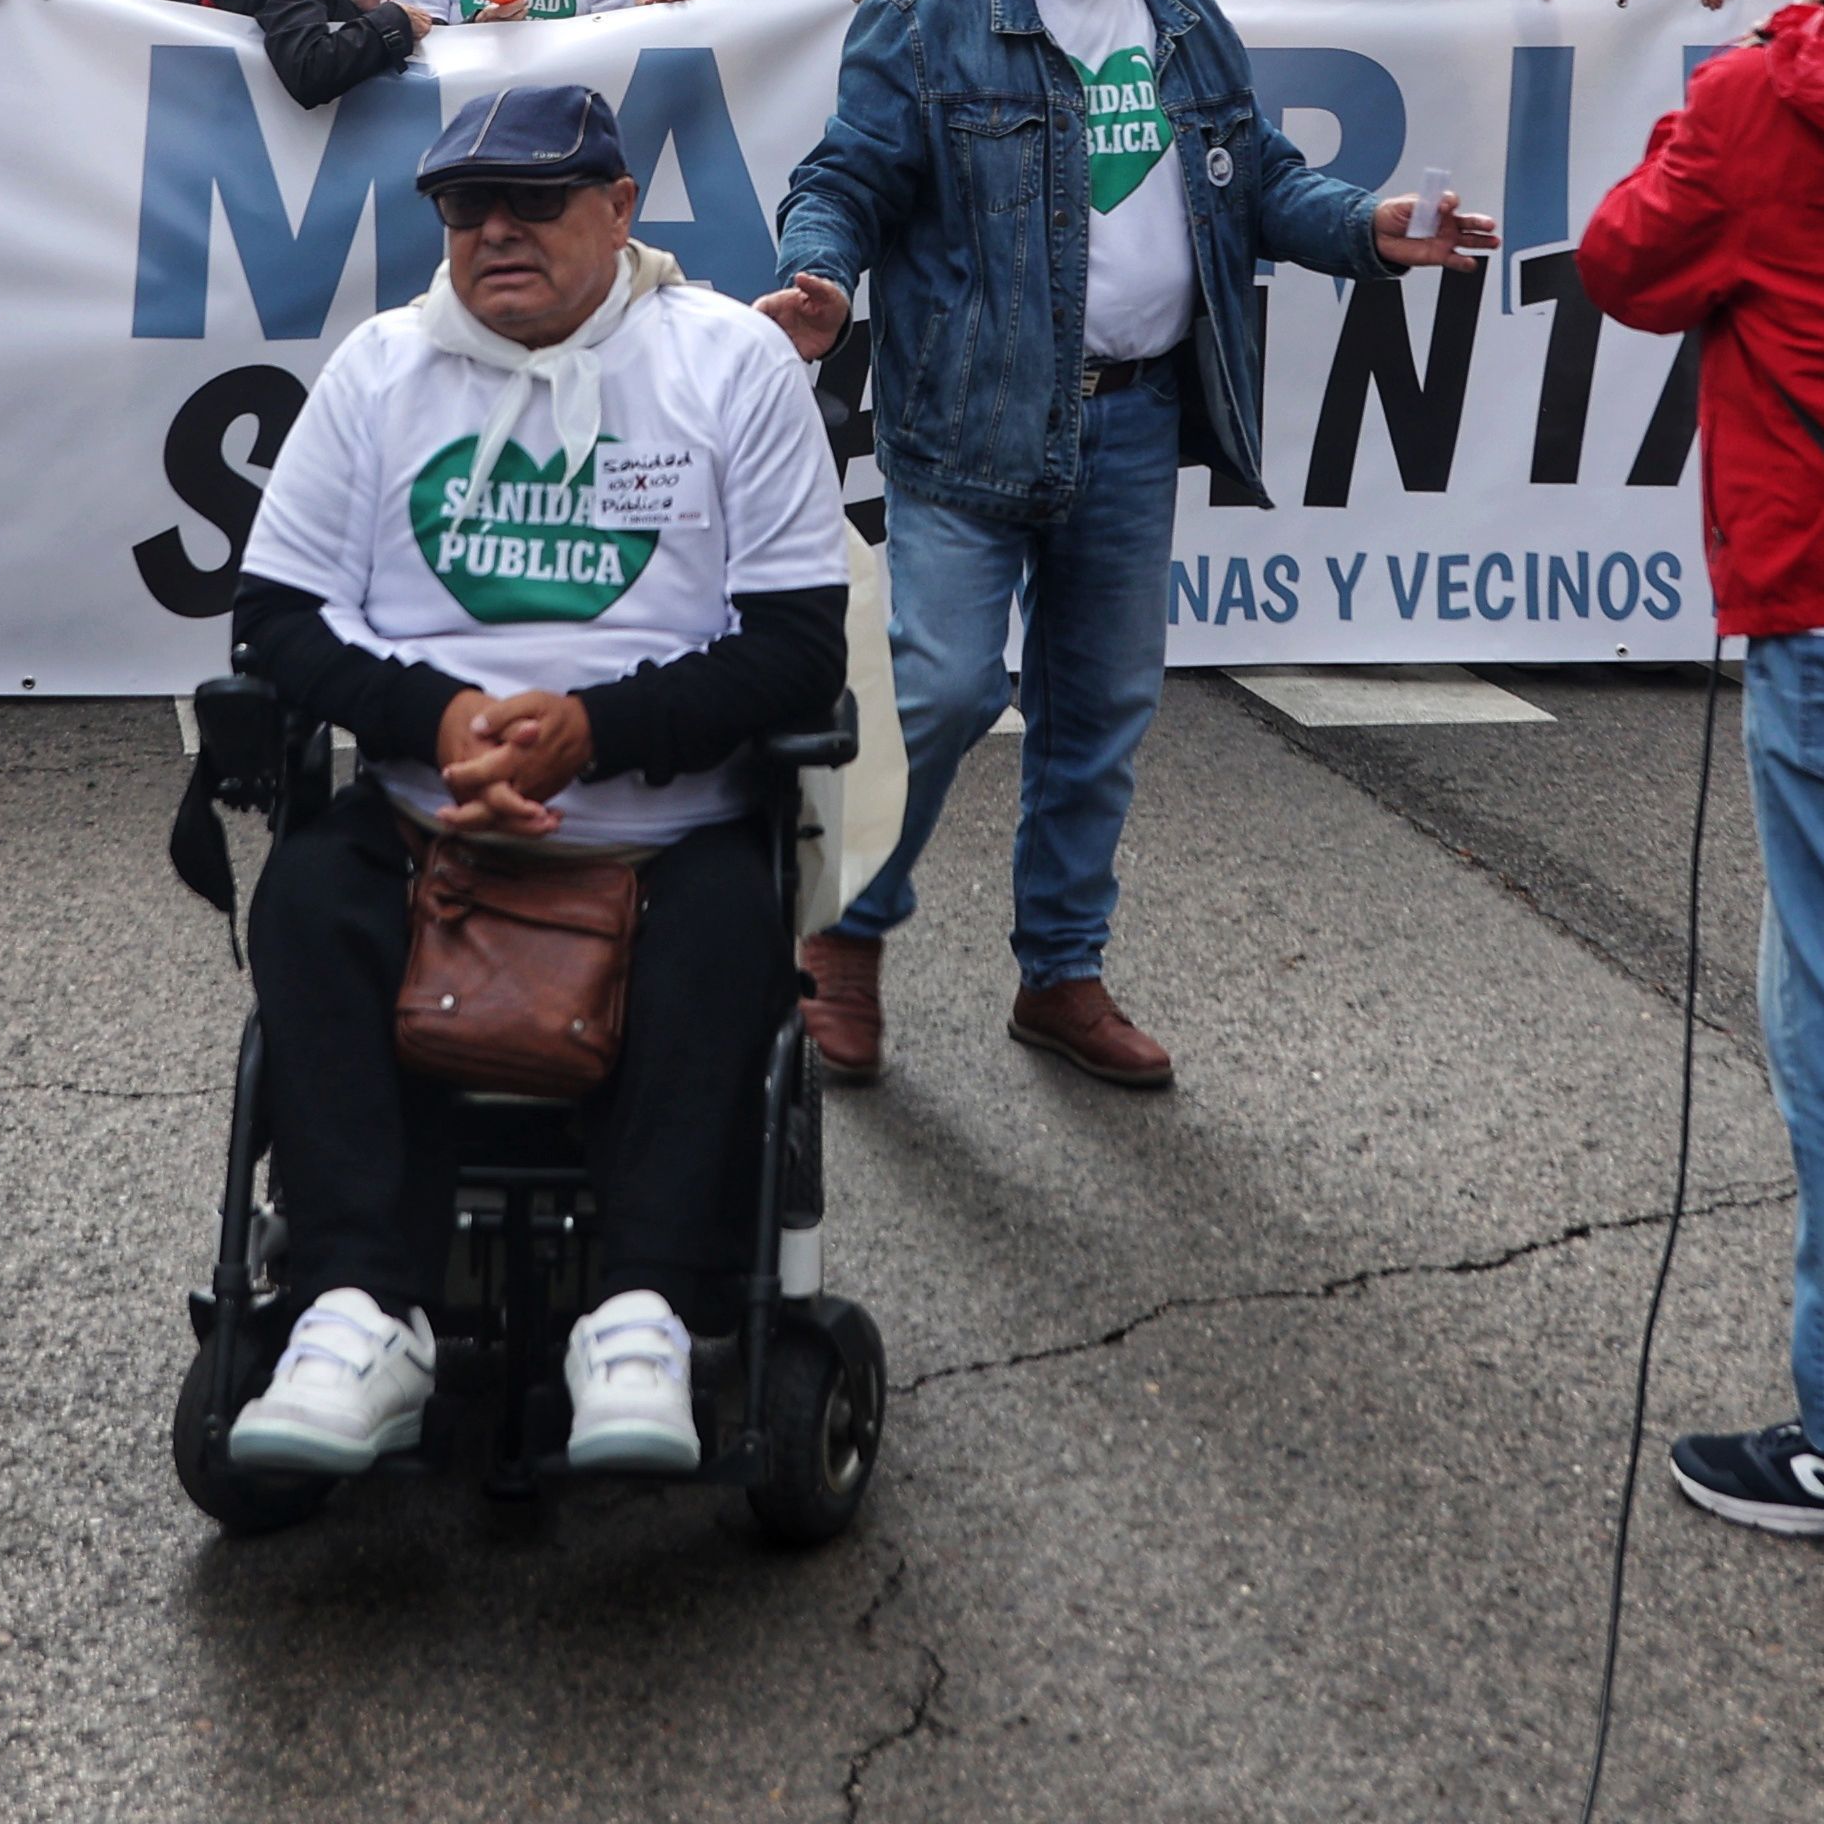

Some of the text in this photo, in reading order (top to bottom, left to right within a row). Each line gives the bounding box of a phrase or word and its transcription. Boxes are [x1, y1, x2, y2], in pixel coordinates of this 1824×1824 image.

[437, 528, 626, 588] PÚBLICA
[1326, 552, 1367, 621] Y
[1385, 550, 1683, 624] VECINOS
